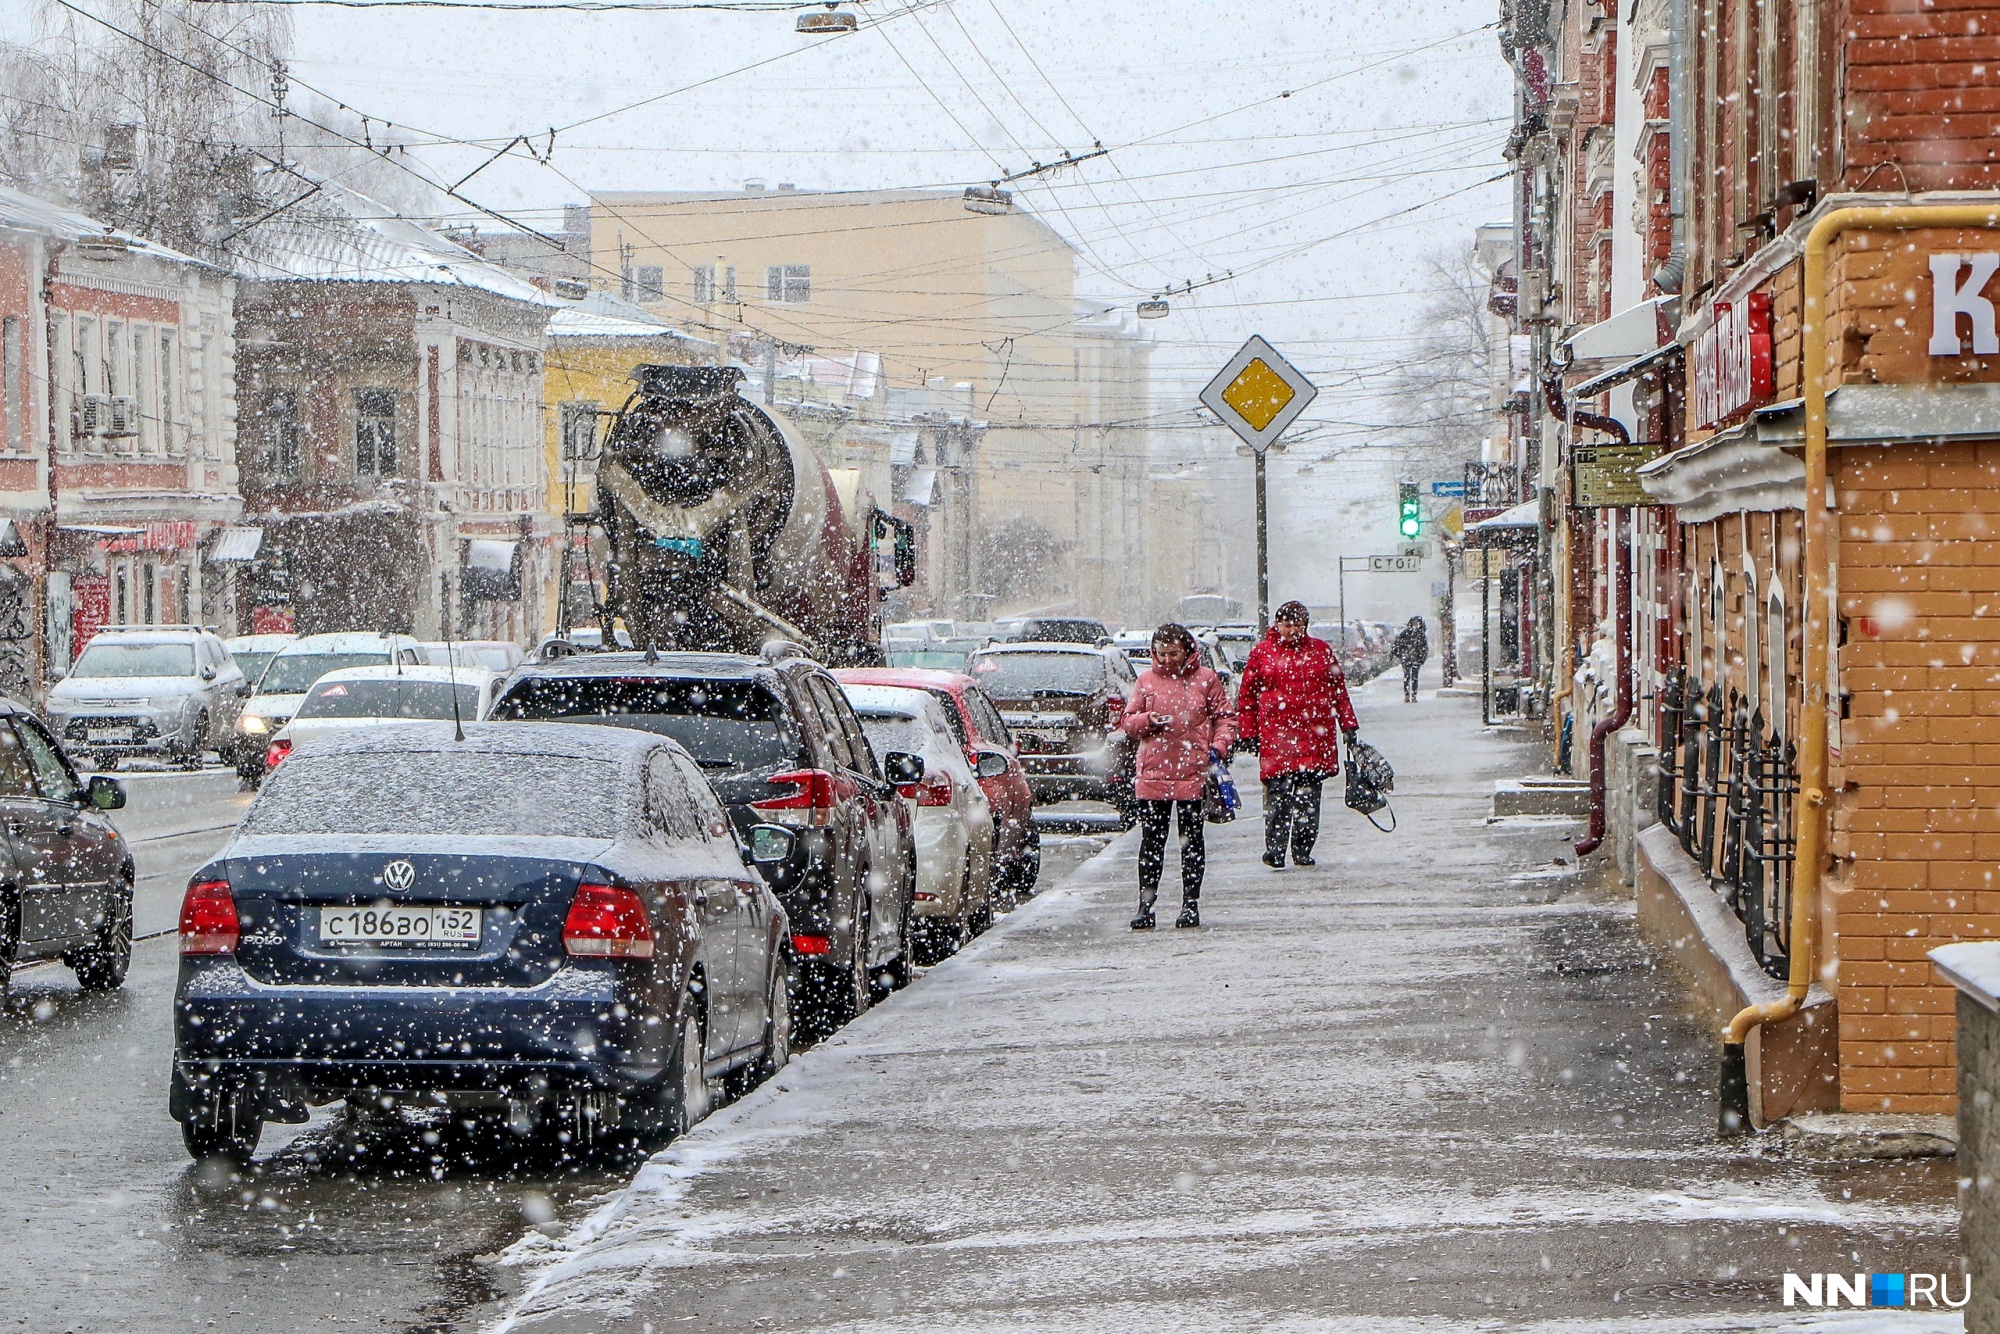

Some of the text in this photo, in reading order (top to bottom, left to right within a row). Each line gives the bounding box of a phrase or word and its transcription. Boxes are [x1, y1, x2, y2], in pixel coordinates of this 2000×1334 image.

[329, 911, 473, 936] С186ВО 152
[443, 930, 463, 938] RUS
[243, 935, 283, 945] POLO
